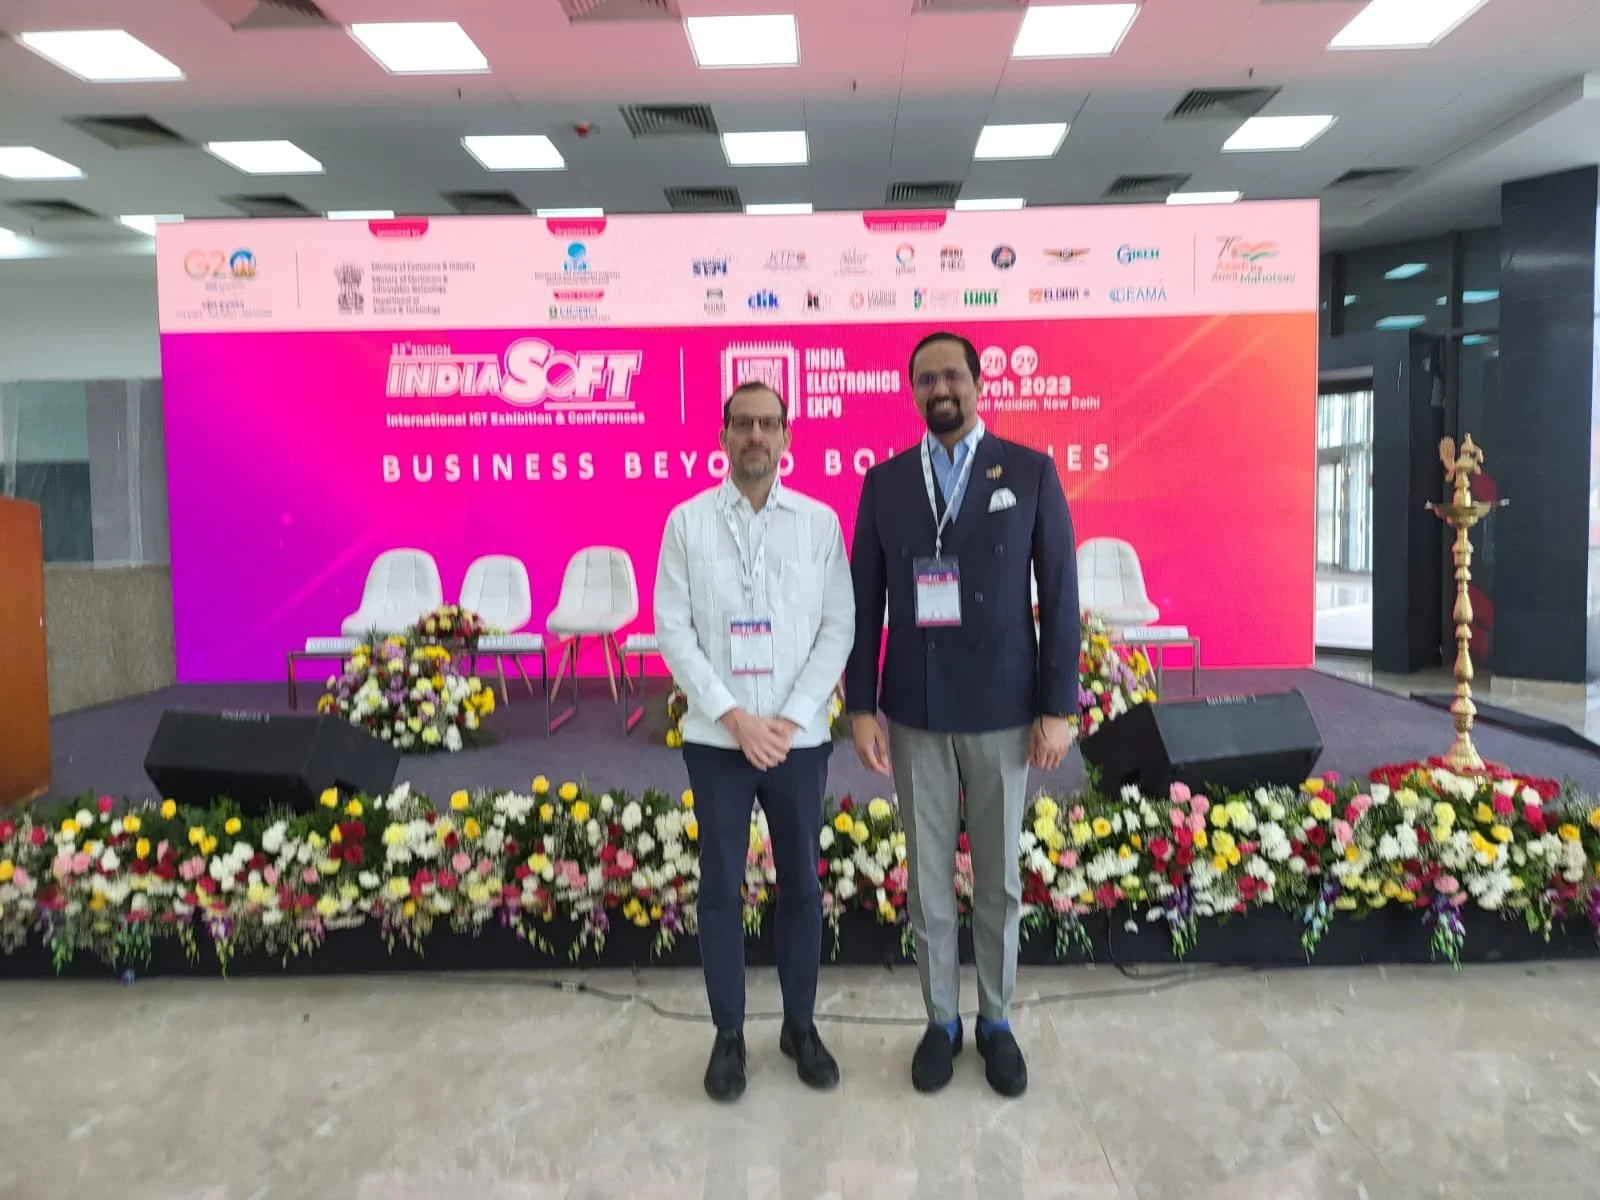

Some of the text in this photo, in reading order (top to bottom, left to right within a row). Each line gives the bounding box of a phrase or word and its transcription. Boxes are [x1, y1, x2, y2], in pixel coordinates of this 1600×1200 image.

[805, 348, 845, 370] INDIA
[806, 370, 900, 395] ELECTRONICS
[983, 375, 1071, 397] rch 2023
[807, 396, 842, 418] EXPO
[1043, 396, 1069, 411] New
[1071, 395, 1101, 411] Delhi
[386, 412, 467, 428] International
[491, 411, 552, 427] Exhibition
[568, 410, 645, 425] Conferences
[383, 452, 595, 483] BUSINESS
[625, 449, 794, 480] BEYOD
